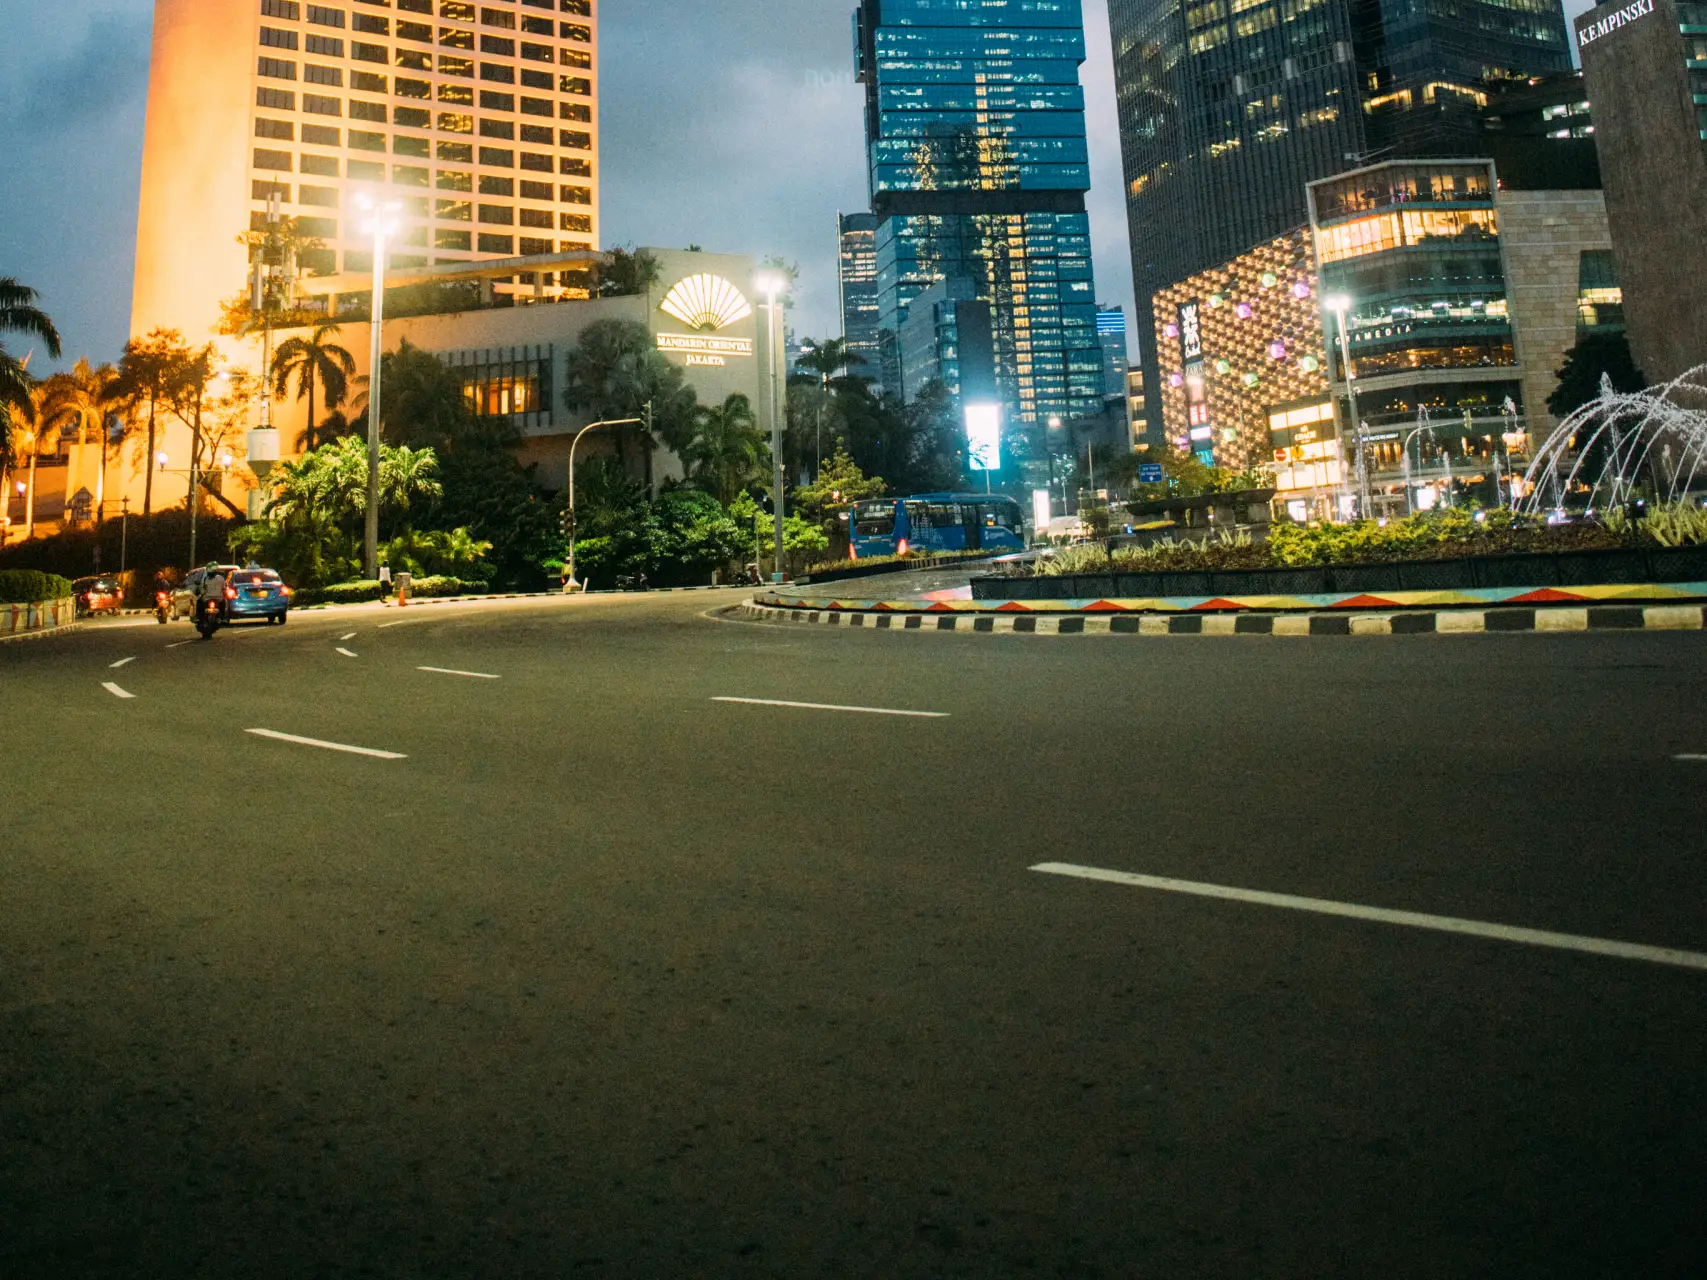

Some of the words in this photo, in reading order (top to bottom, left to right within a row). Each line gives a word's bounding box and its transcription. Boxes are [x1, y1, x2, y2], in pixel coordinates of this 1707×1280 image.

[657, 337, 706, 348] MANDARIN
[708, 339, 752, 351] ORIENTAL
[686, 354, 724, 366] JAKARTA
